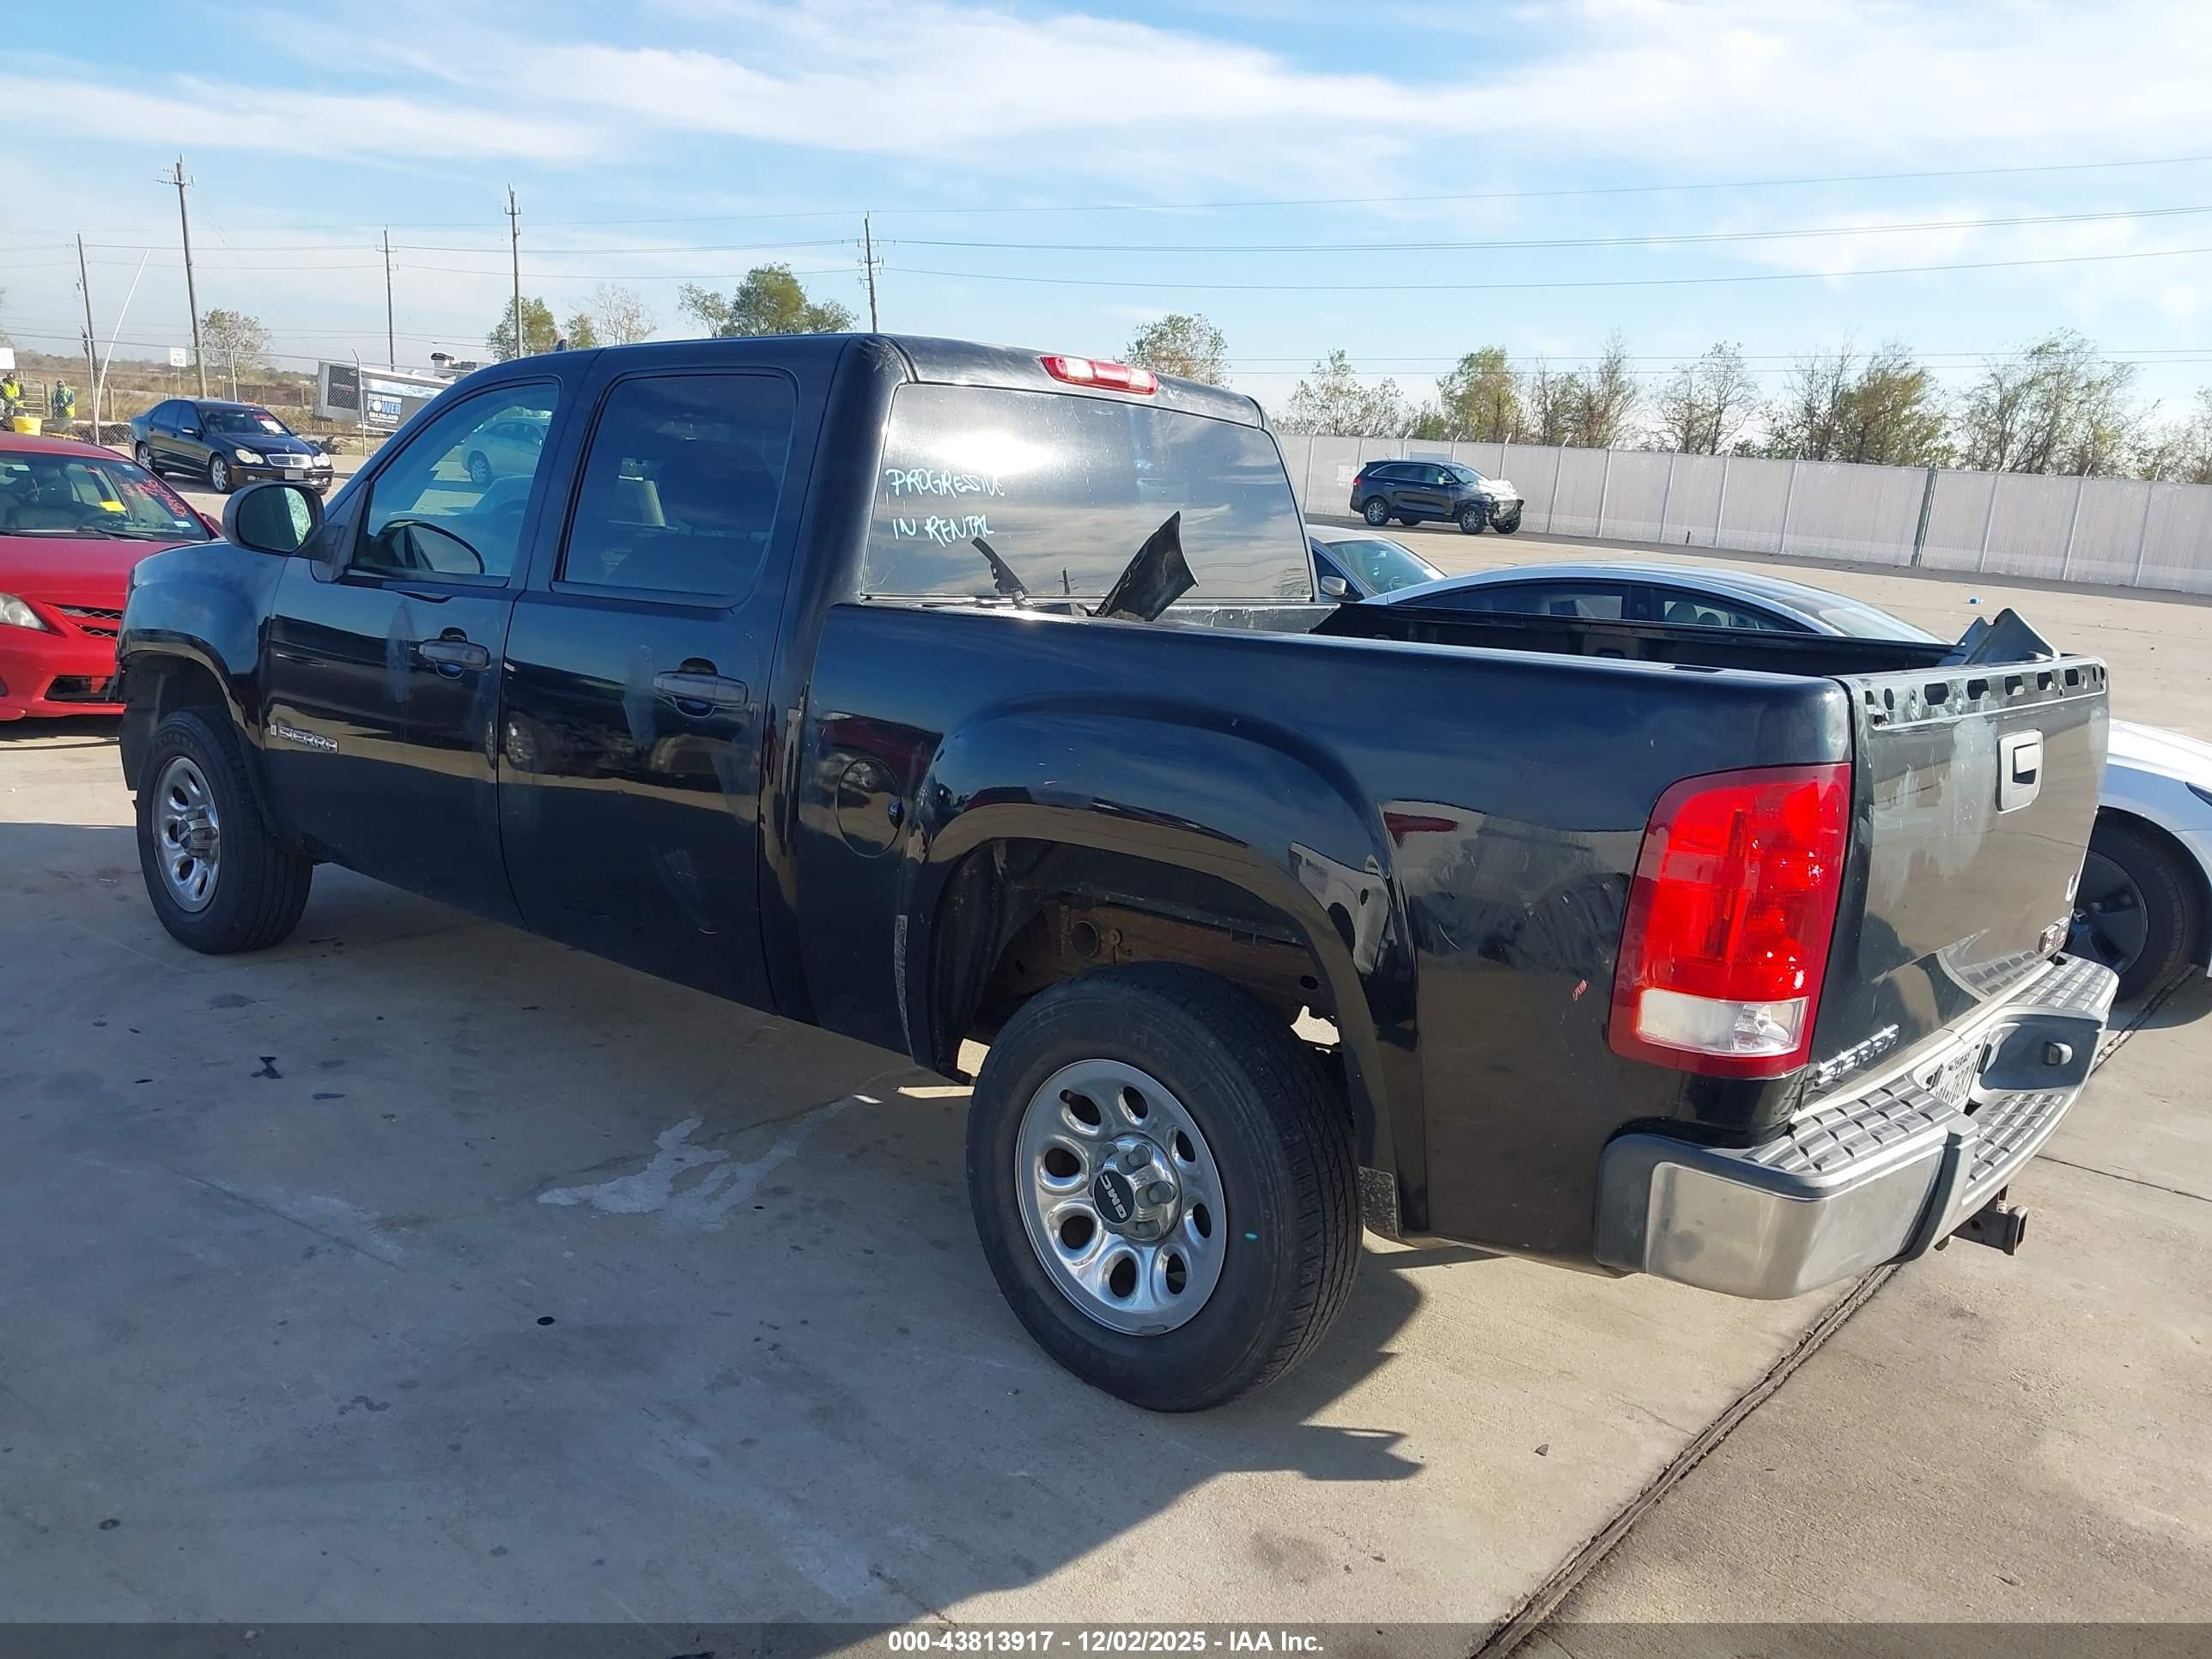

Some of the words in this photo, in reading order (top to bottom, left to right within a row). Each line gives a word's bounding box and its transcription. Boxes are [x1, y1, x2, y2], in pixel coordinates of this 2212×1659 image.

[885, 468, 1005, 499] PROGRESSIVE
[892, 517, 917, 541] IN
[924, 514, 995, 548] RENTAL
[279, 726, 339, 754] SIERRA
[1816, 1024, 1901, 1085] SIERRA
[1099, 1174, 1127, 1219] GMC
